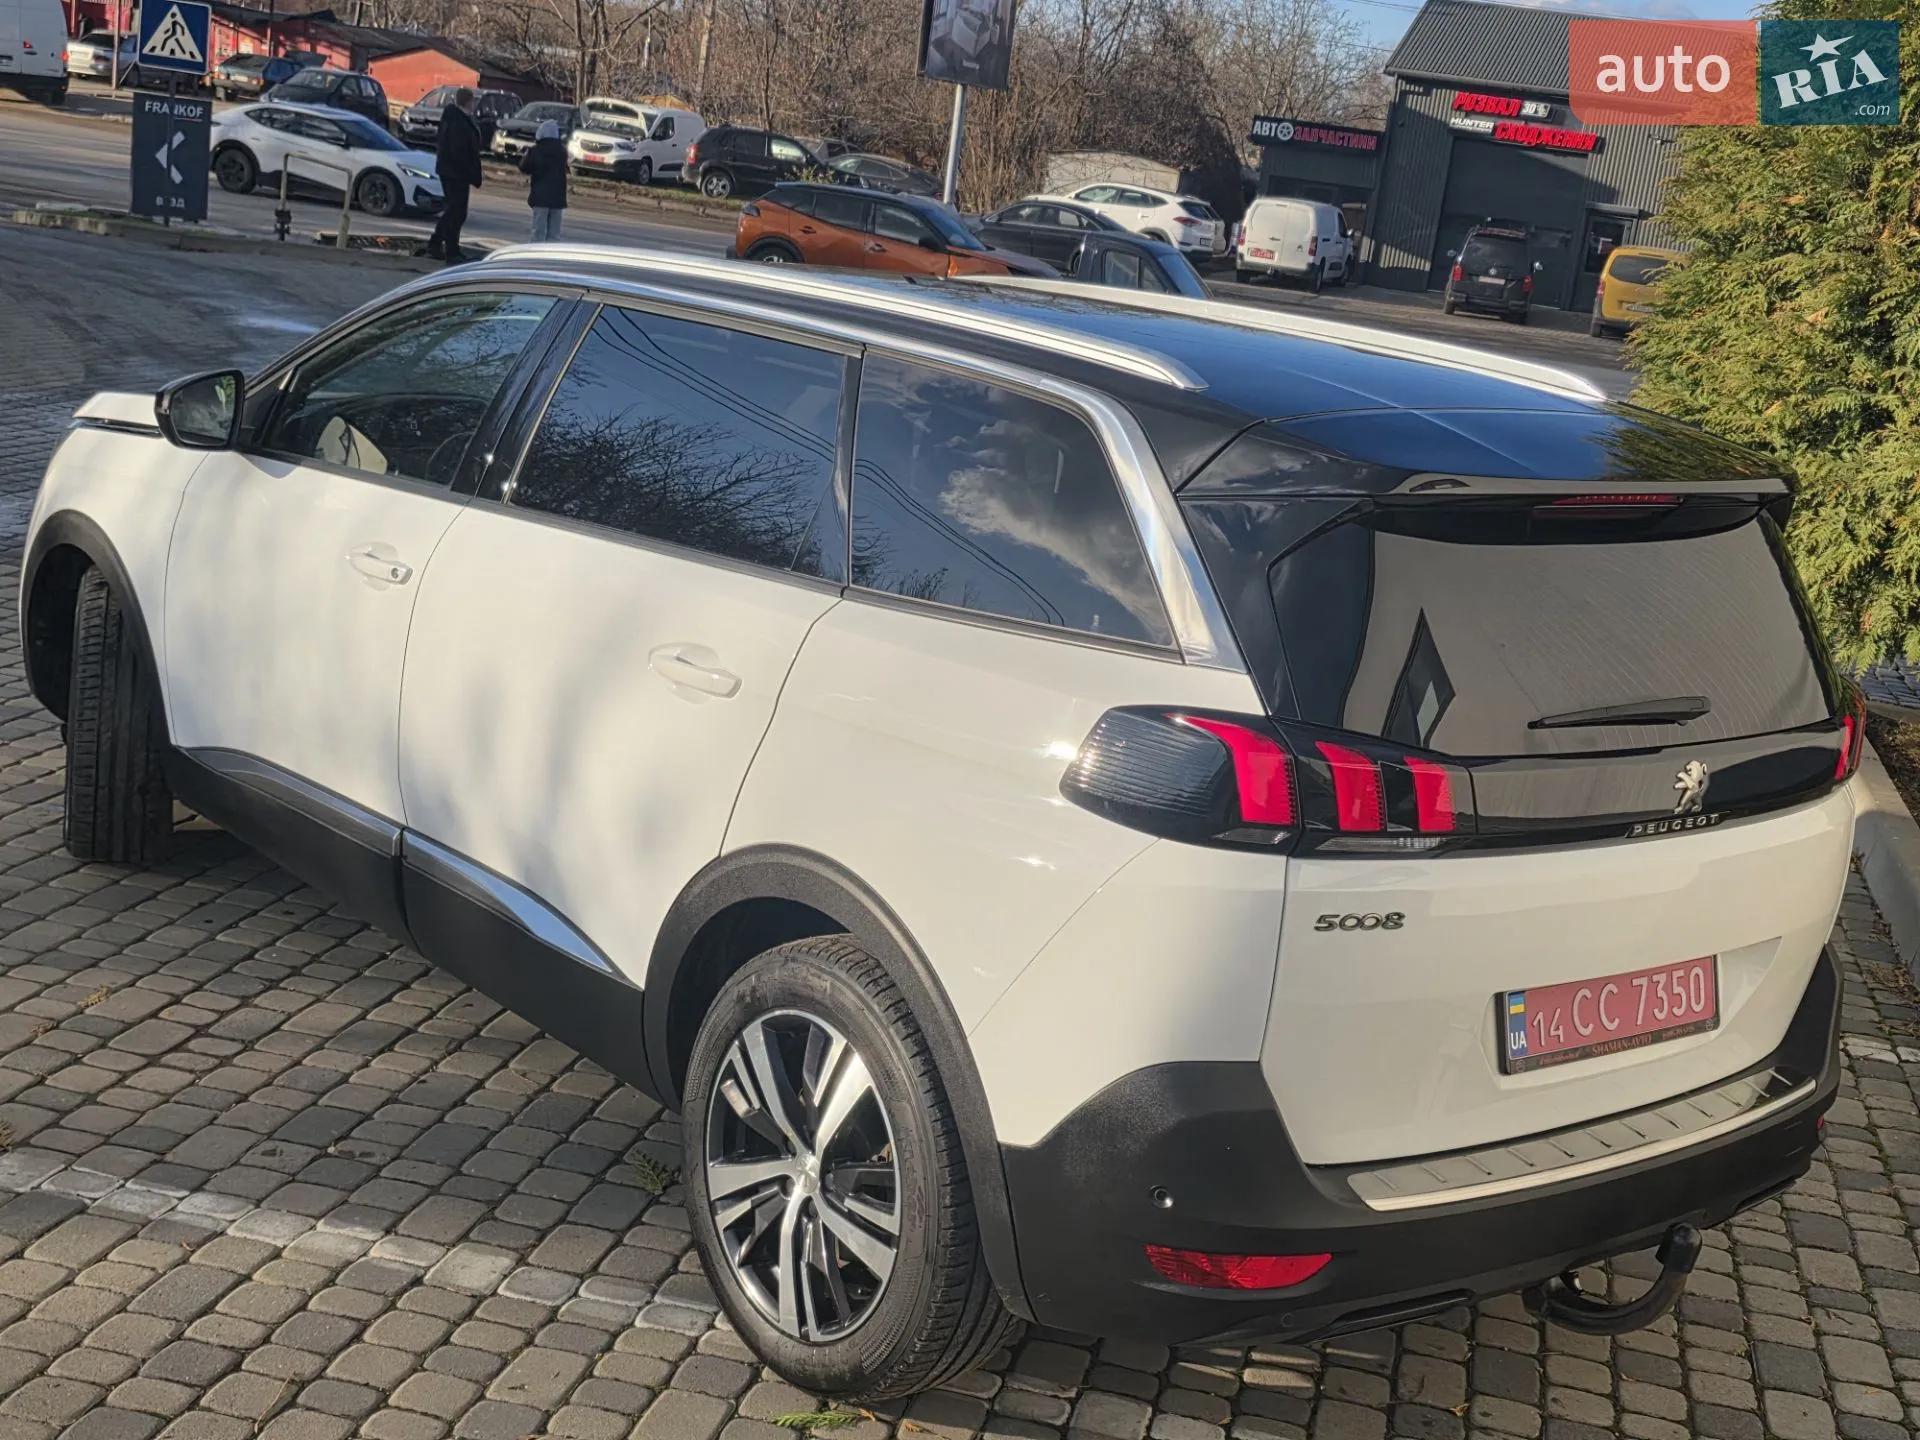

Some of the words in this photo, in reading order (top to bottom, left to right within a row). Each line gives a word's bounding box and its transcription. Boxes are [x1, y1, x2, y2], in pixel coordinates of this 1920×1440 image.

[1453, 92, 1522, 117] РОЗВАЛ
[1450, 117, 1495, 129] HUNTER
[1494, 122, 1597, 150] СХОДЖЕННЯ
[1630, 814, 1719, 836] PEUGEOT
[1314, 911, 1406, 932] 5008
[1531, 1007, 1565, 1048] 14
[1572, 983, 1620, 1037] CC
[1631, 966, 1706, 1027] 7350
[1510, 1030, 1527, 1050] UA
